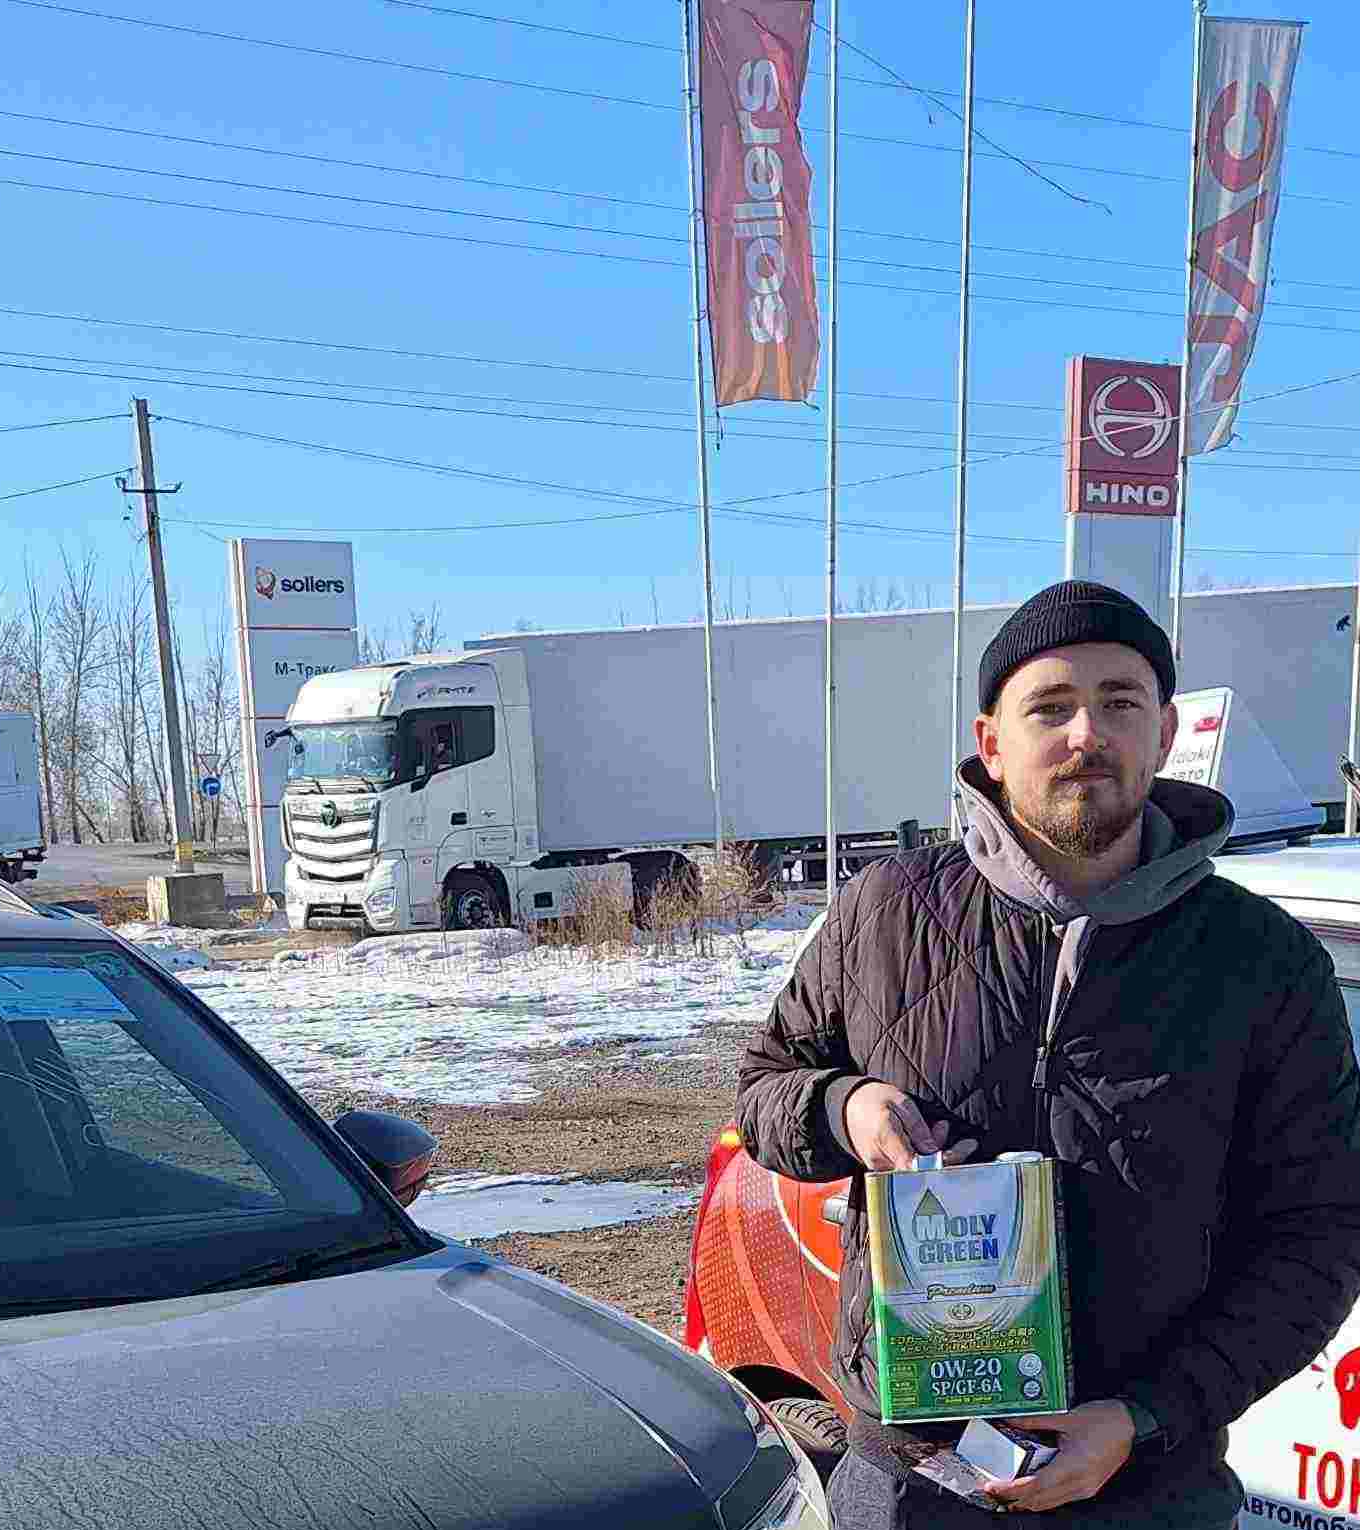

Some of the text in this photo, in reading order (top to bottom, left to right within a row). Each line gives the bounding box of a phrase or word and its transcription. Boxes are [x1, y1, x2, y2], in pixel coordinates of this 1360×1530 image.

[735, 56, 788, 345] sollers
[1085, 480, 1171, 508] HINO
[281, 576, 345, 593] sollers
[915, 1213, 996, 1240] MOLY
[918, 1239, 999, 1264] GREEN
[931, 1378, 1004, 1397] SP/GF-6A
